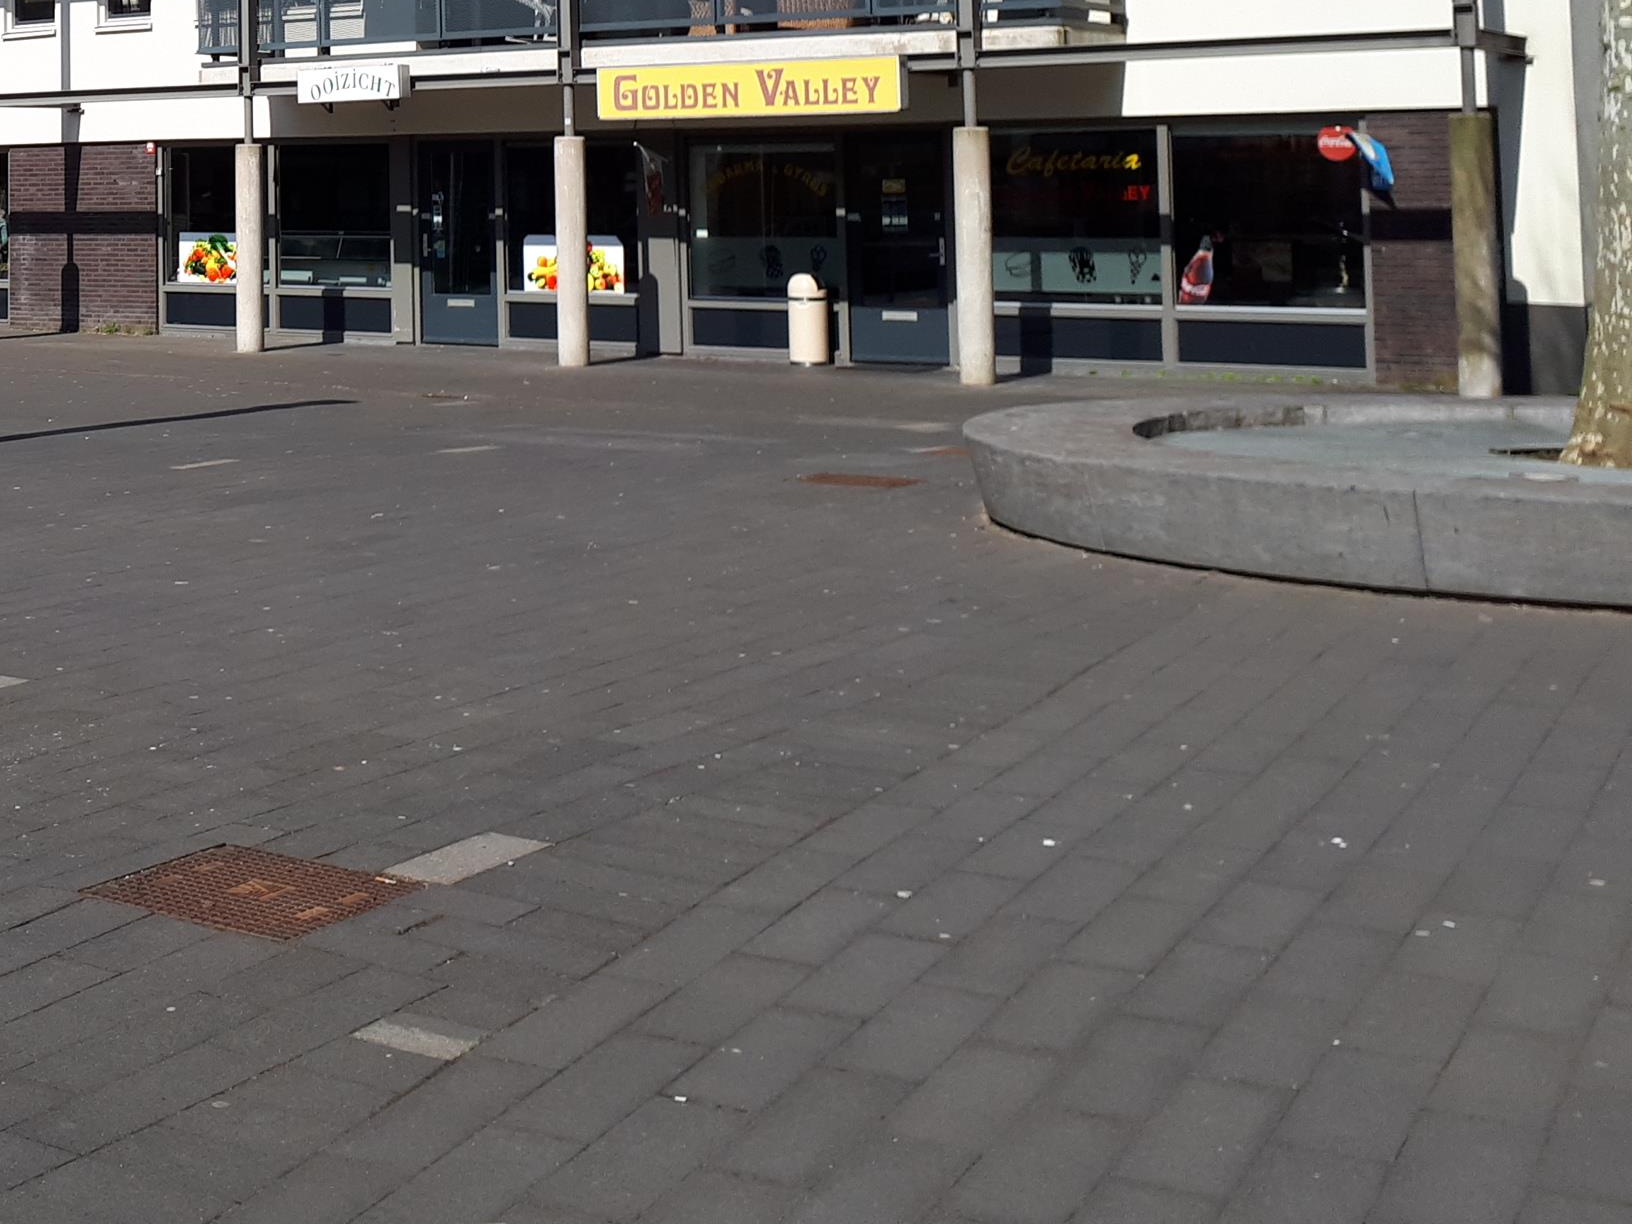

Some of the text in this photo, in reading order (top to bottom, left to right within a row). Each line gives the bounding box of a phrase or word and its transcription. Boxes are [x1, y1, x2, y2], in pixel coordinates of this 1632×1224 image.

[614, 68, 881, 111] GOLDEN VALLEY
[1006, 146, 1142, 177] Cafetaria
